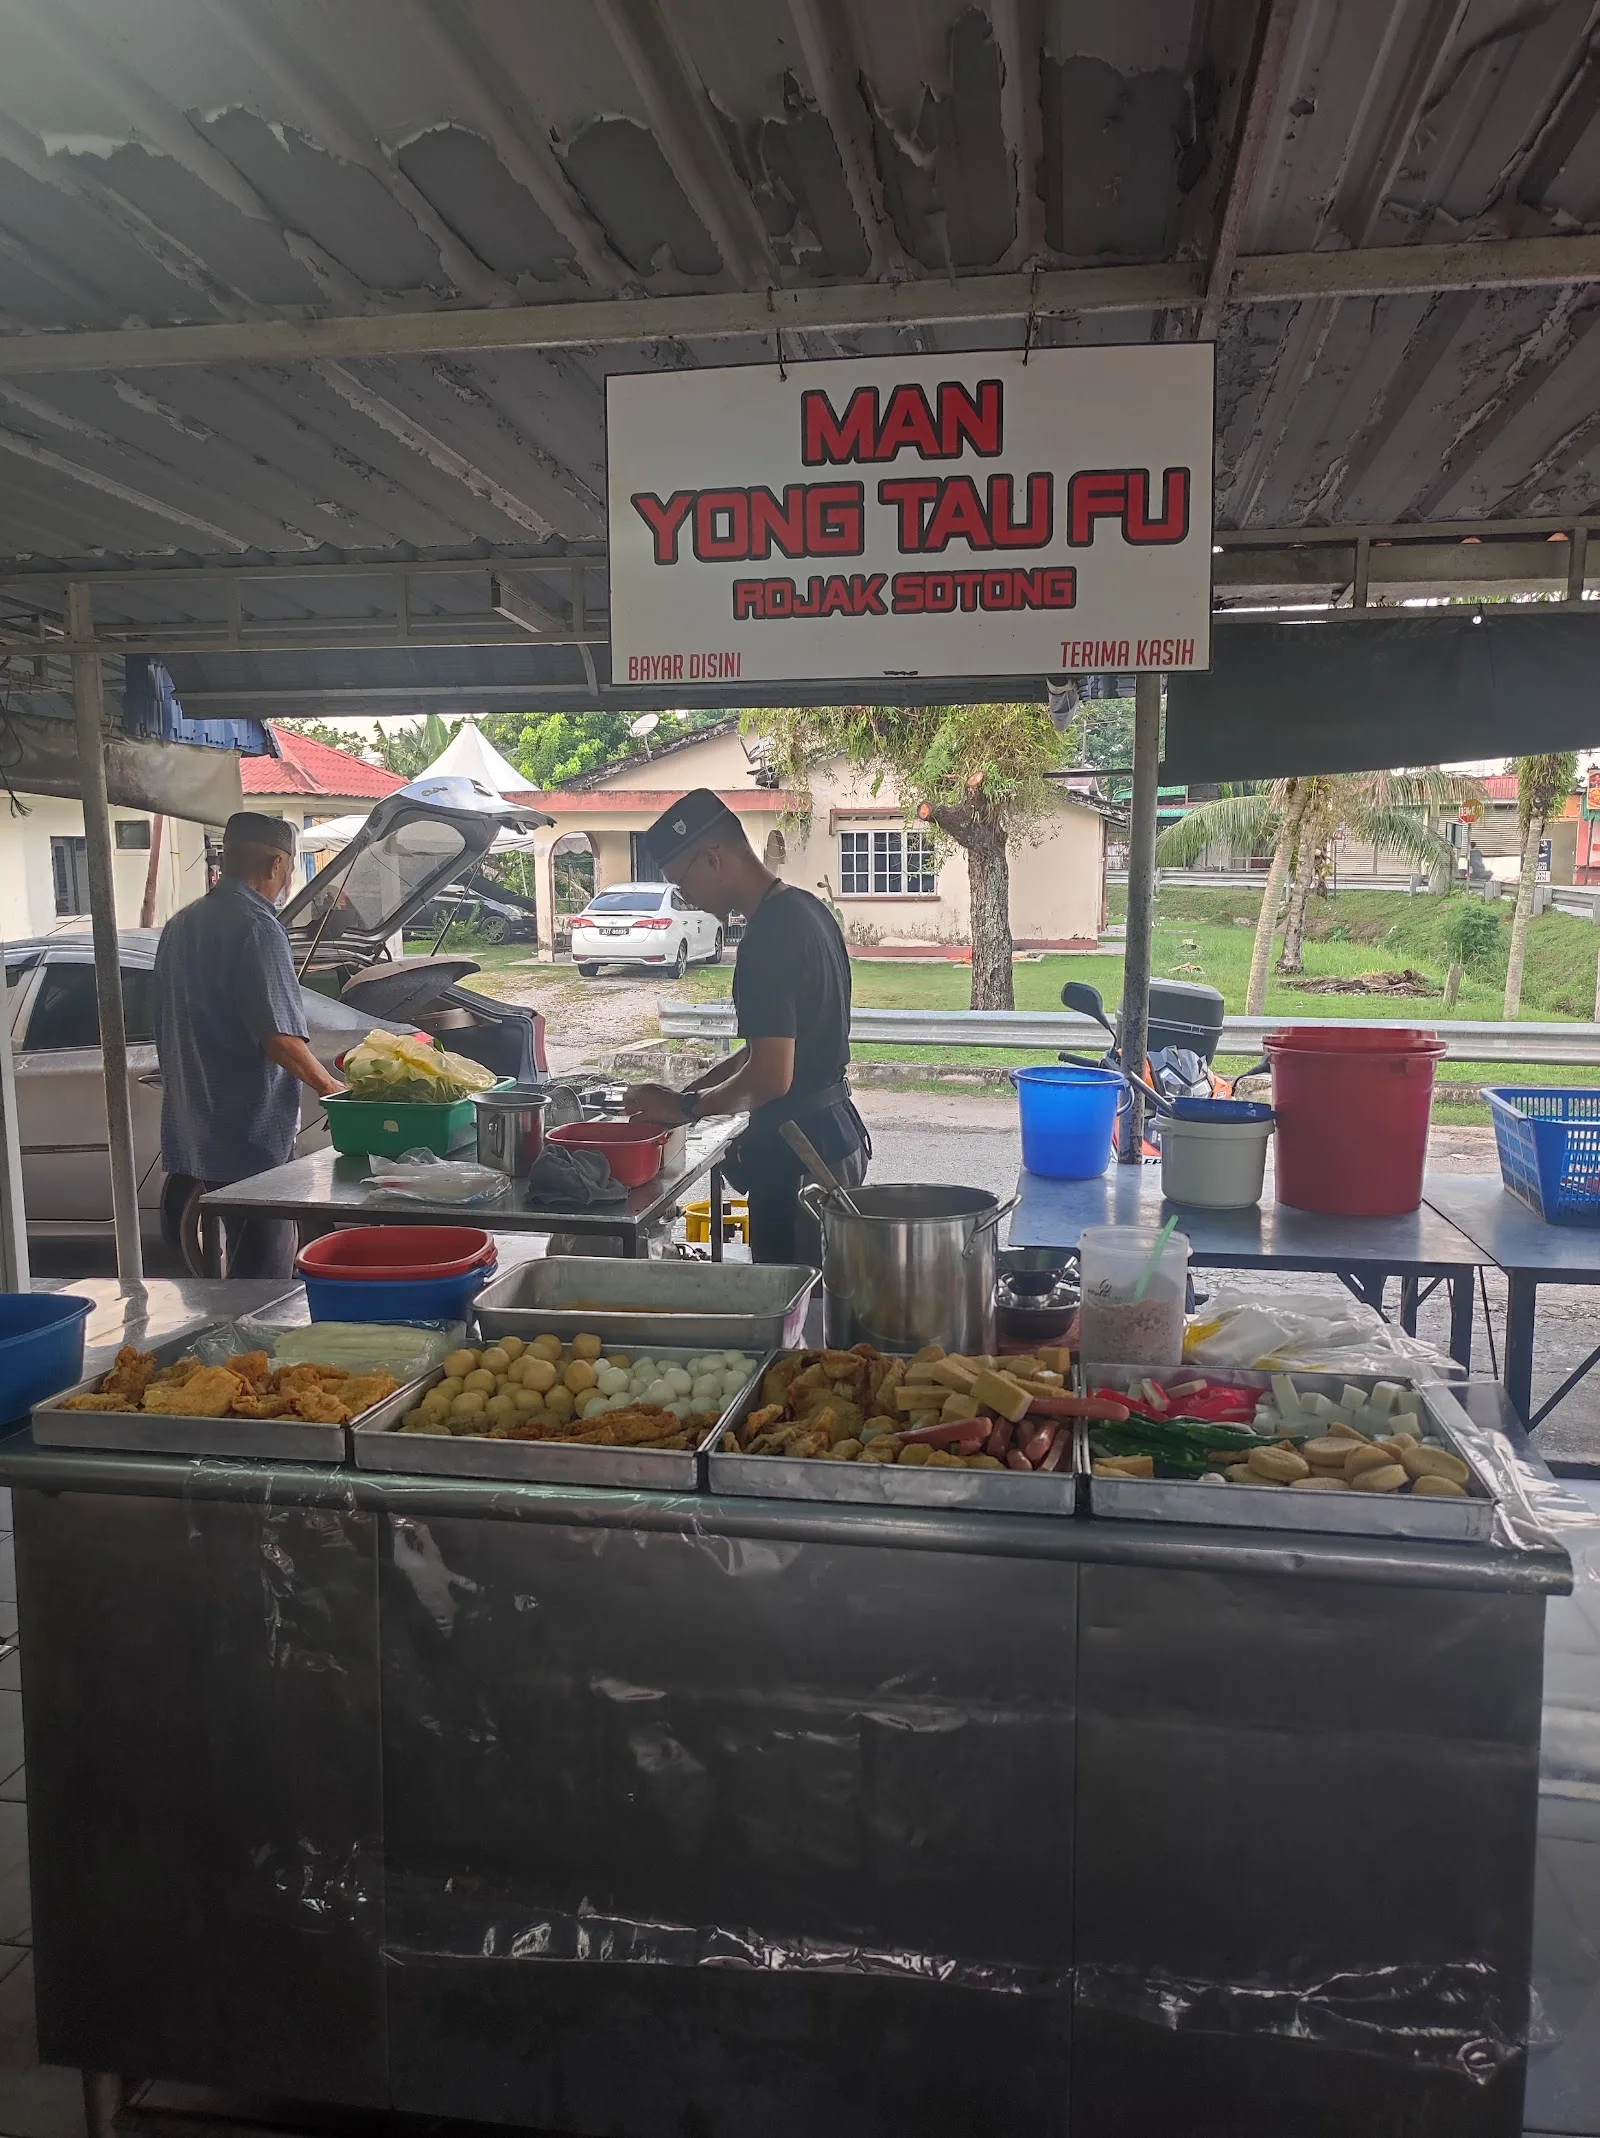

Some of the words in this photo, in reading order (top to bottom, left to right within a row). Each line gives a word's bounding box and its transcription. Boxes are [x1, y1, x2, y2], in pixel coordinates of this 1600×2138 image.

[801, 379, 1004, 466] MAN
[631, 480, 866, 565] YONG
[878, 472, 1054, 554] TAU
[1067, 467, 1191, 548] FU
[733, 572, 888, 621] ROJAK
[891, 566, 1077, 615] SOTONG
[628, 654, 684, 681] BAYAR
[689, 652, 741, 679] DISINI
[1061, 640, 1130, 668] TERIMA
[1136, 638, 1195, 666] KASIH
